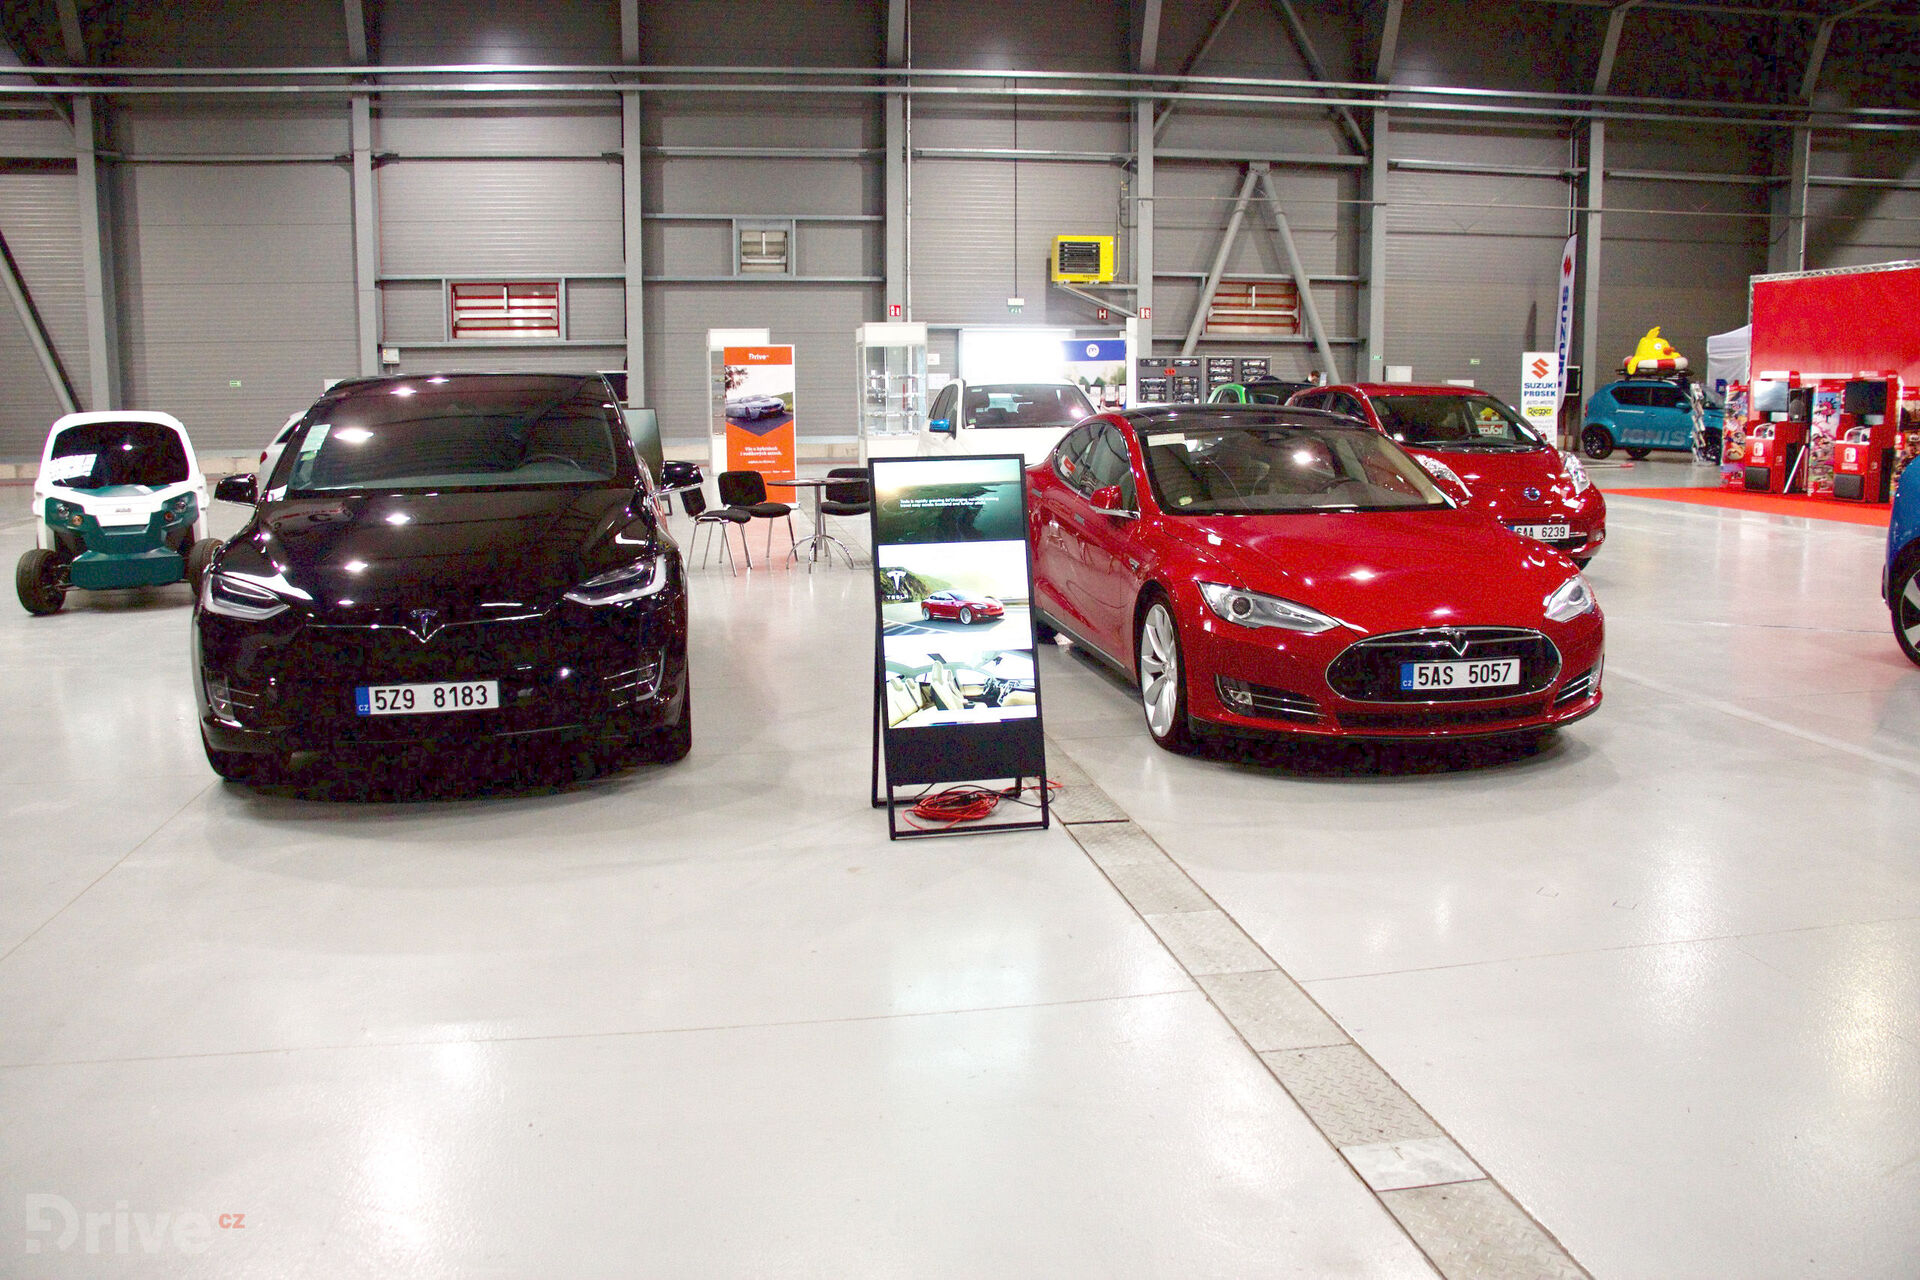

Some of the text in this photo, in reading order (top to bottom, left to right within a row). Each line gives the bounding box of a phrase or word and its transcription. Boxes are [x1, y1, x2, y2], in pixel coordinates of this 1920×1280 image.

[1620, 428, 1686, 446] IGNIS
[1541, 526, 1566, 538] 6239
[1418, 666, 1454, 686] 5AS
[1469, 662, 1512, 684] 5057
[358, 684, 488, 712] CZ 5Z9 8183
